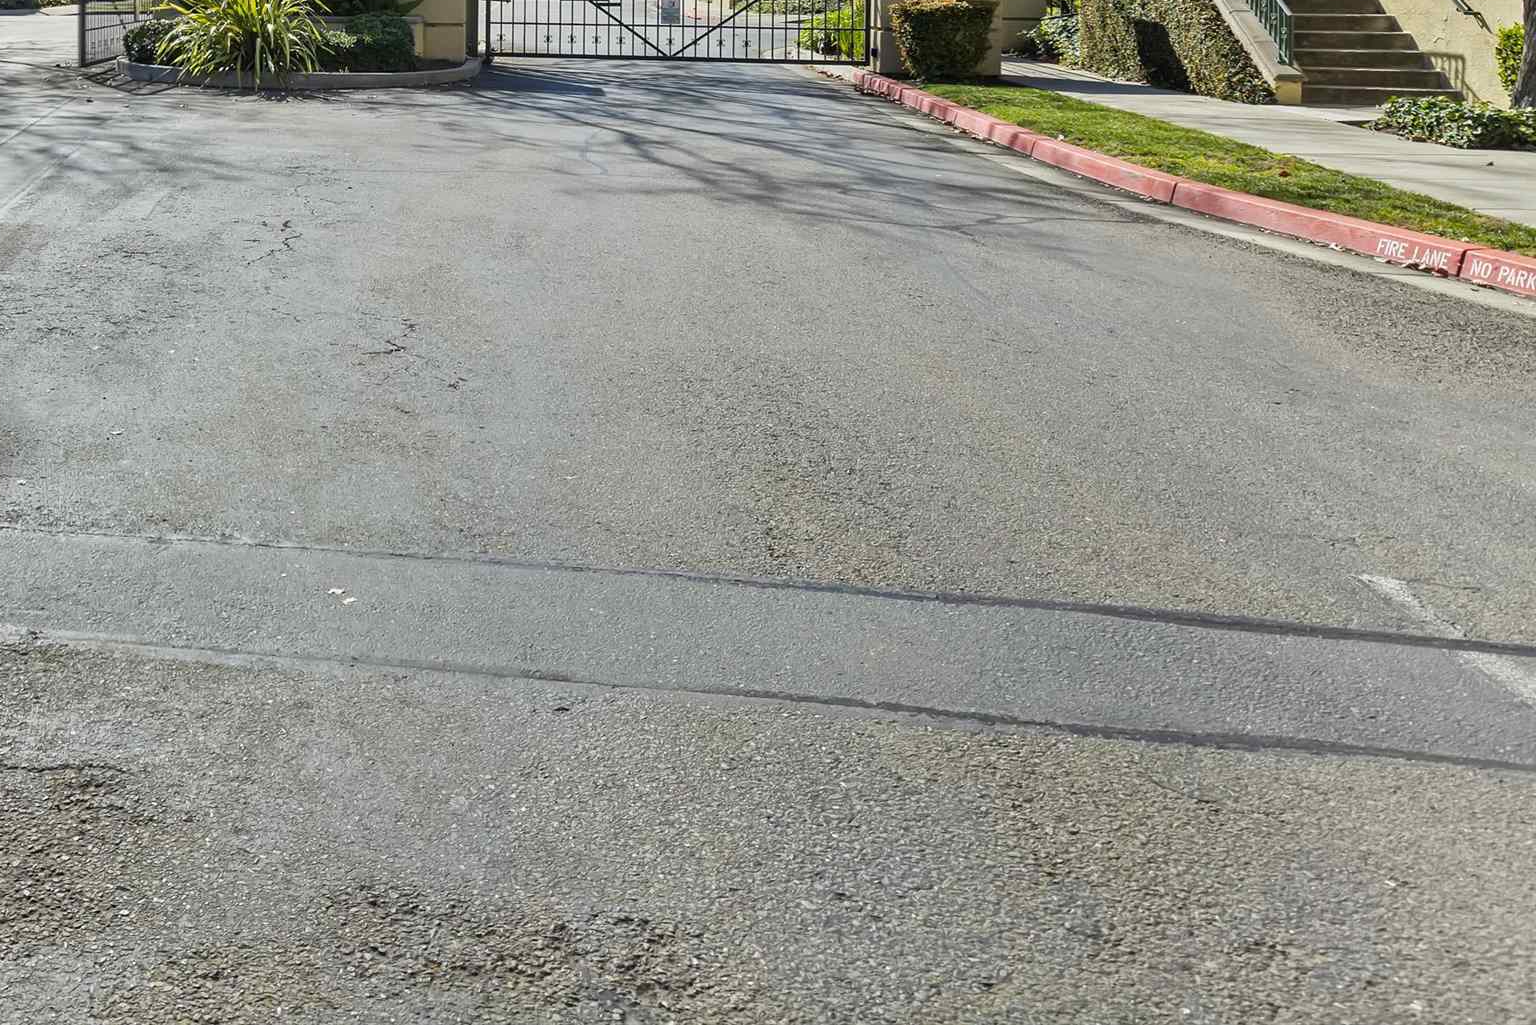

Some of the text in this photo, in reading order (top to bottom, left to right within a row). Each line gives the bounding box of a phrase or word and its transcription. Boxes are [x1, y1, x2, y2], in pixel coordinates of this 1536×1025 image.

[1376, 238, 1408, 258] FIRE
[1413, 246, 1452, 269] LANE
[1469, 259, 1492, 278] NO
